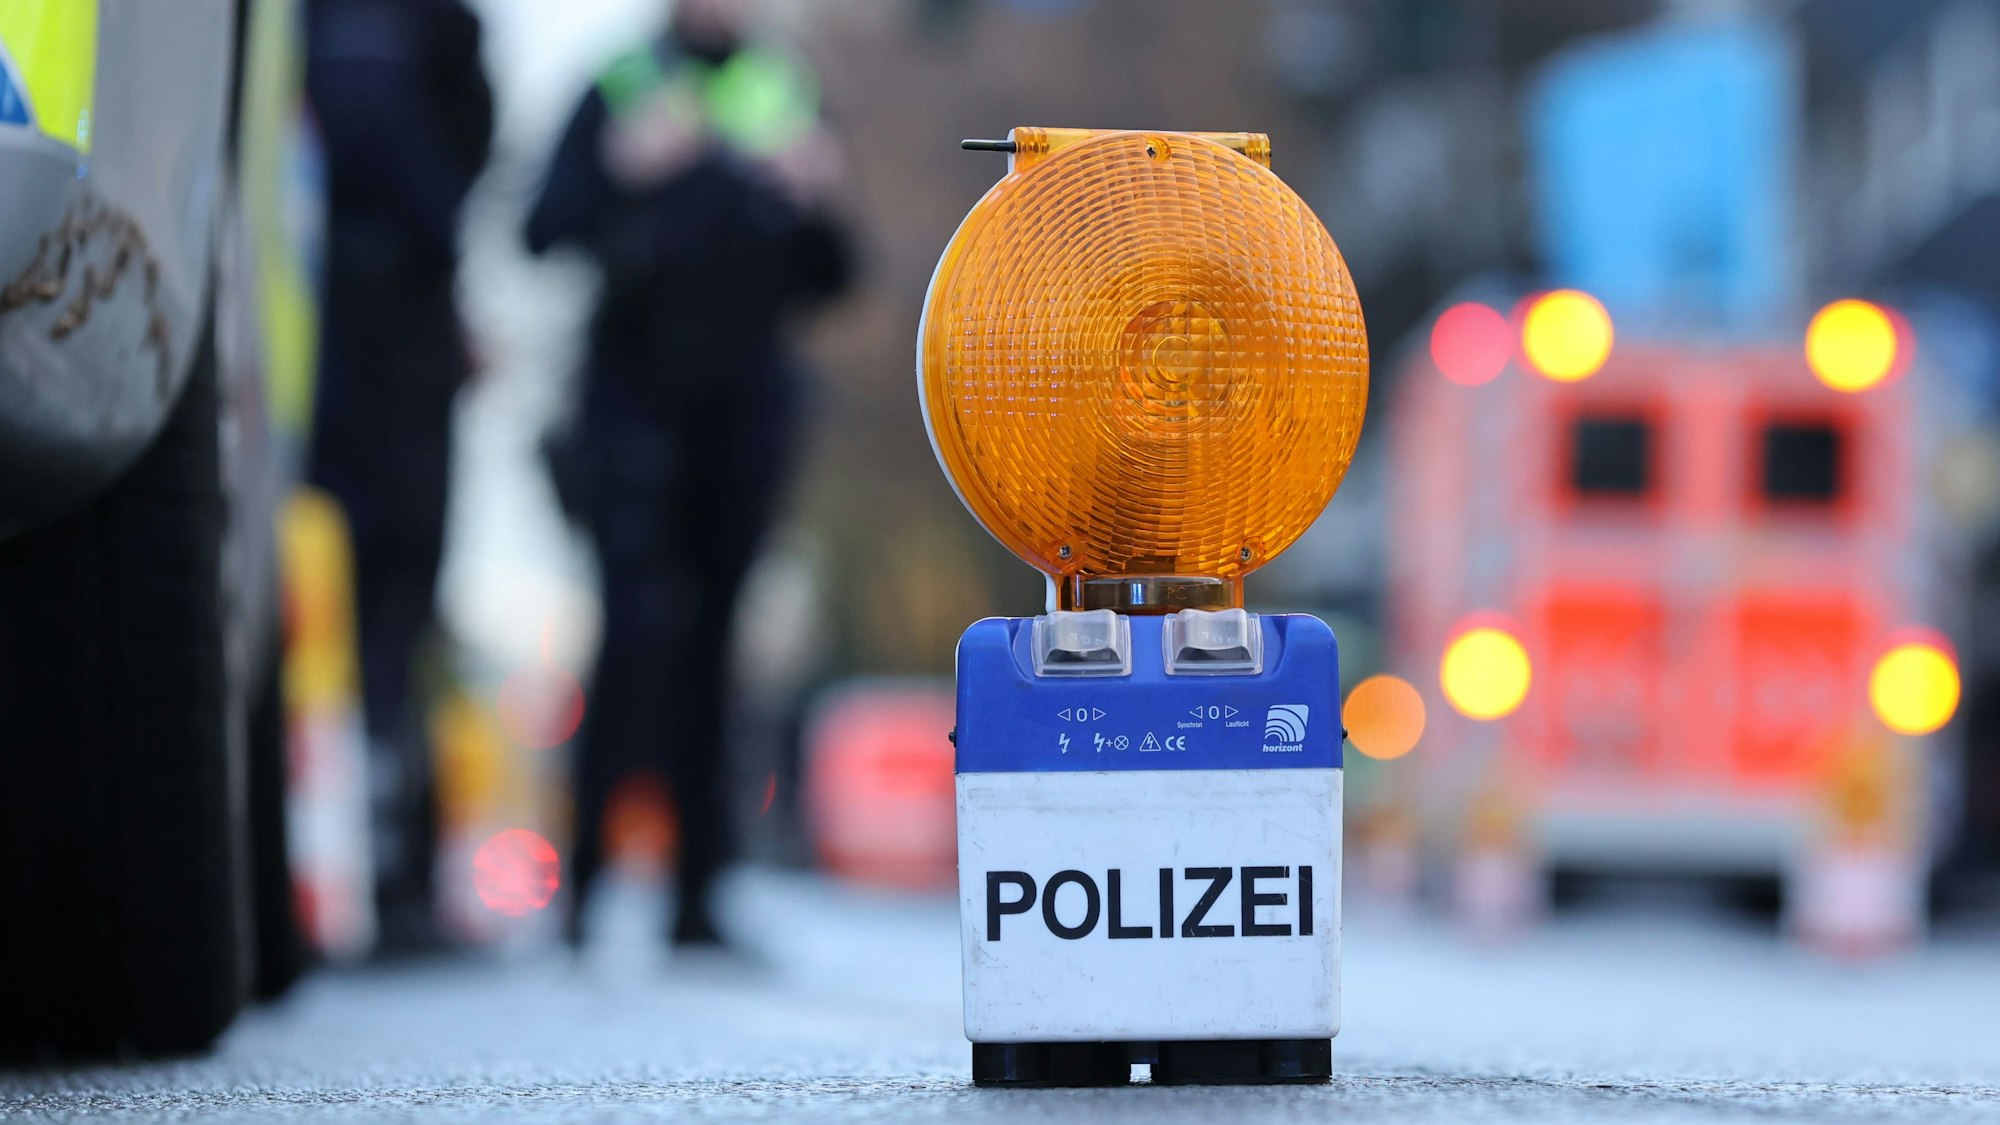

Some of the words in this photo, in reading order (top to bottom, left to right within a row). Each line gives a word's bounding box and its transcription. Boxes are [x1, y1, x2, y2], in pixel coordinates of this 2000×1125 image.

[1176, 721, 1203, 730] Synchron
[1225, 720, 1250, 728] Lauflicht
[1262, 743, 1303, 752] horizont
[986, 865, 1313, 941] POLIZEI
